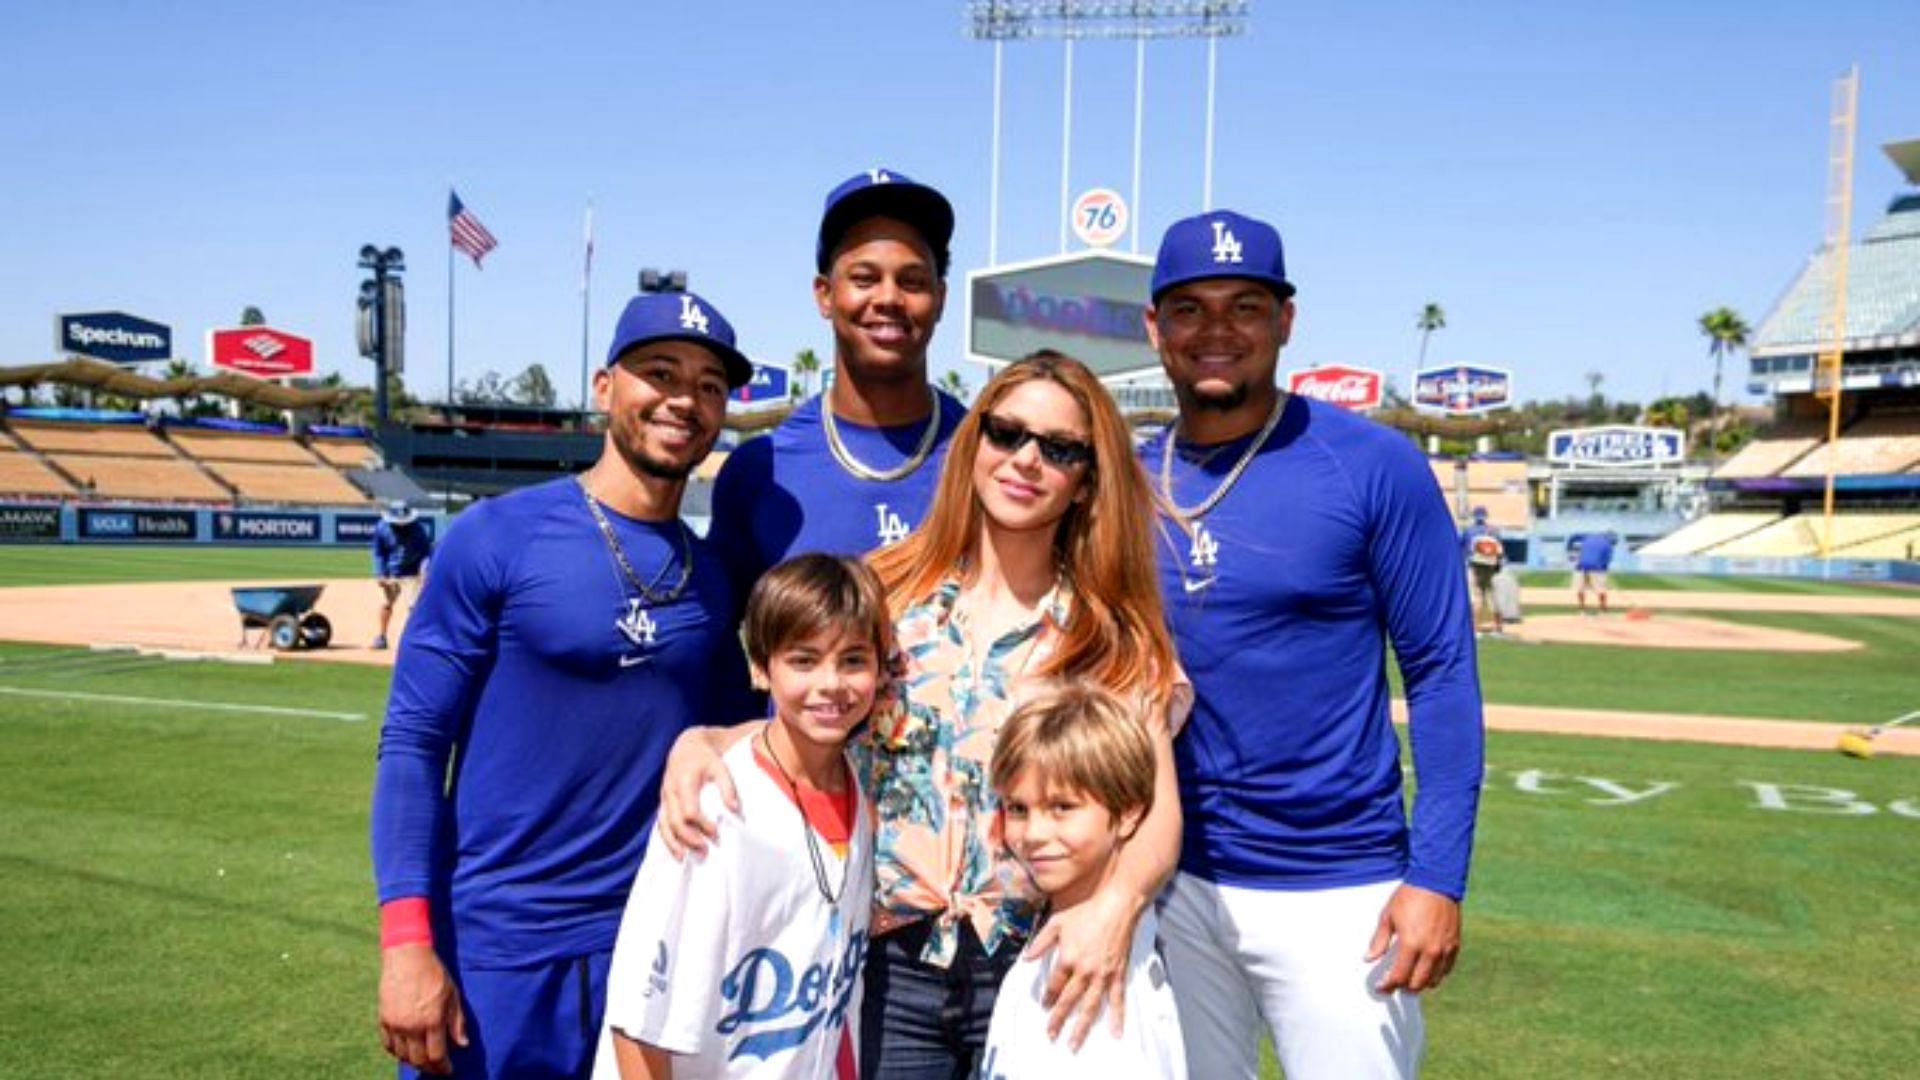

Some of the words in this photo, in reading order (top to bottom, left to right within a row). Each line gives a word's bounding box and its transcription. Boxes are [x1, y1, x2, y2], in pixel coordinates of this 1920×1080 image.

[1085, 202, 1116, 230] 76
[1211, 221, 1243, 263] LA
[680, 295, 709, 334] LA
[69, 322, 163, 349] Spectrum
[92, 517, 129, 531] UCLA
[137, 516, 189, 533] Health
[239, 518, 314, 535] MORTON
[876, 503, 910, 547] LA
[1190, 522, 1219, 566] LA
[625, 597, 657, 645] LA
